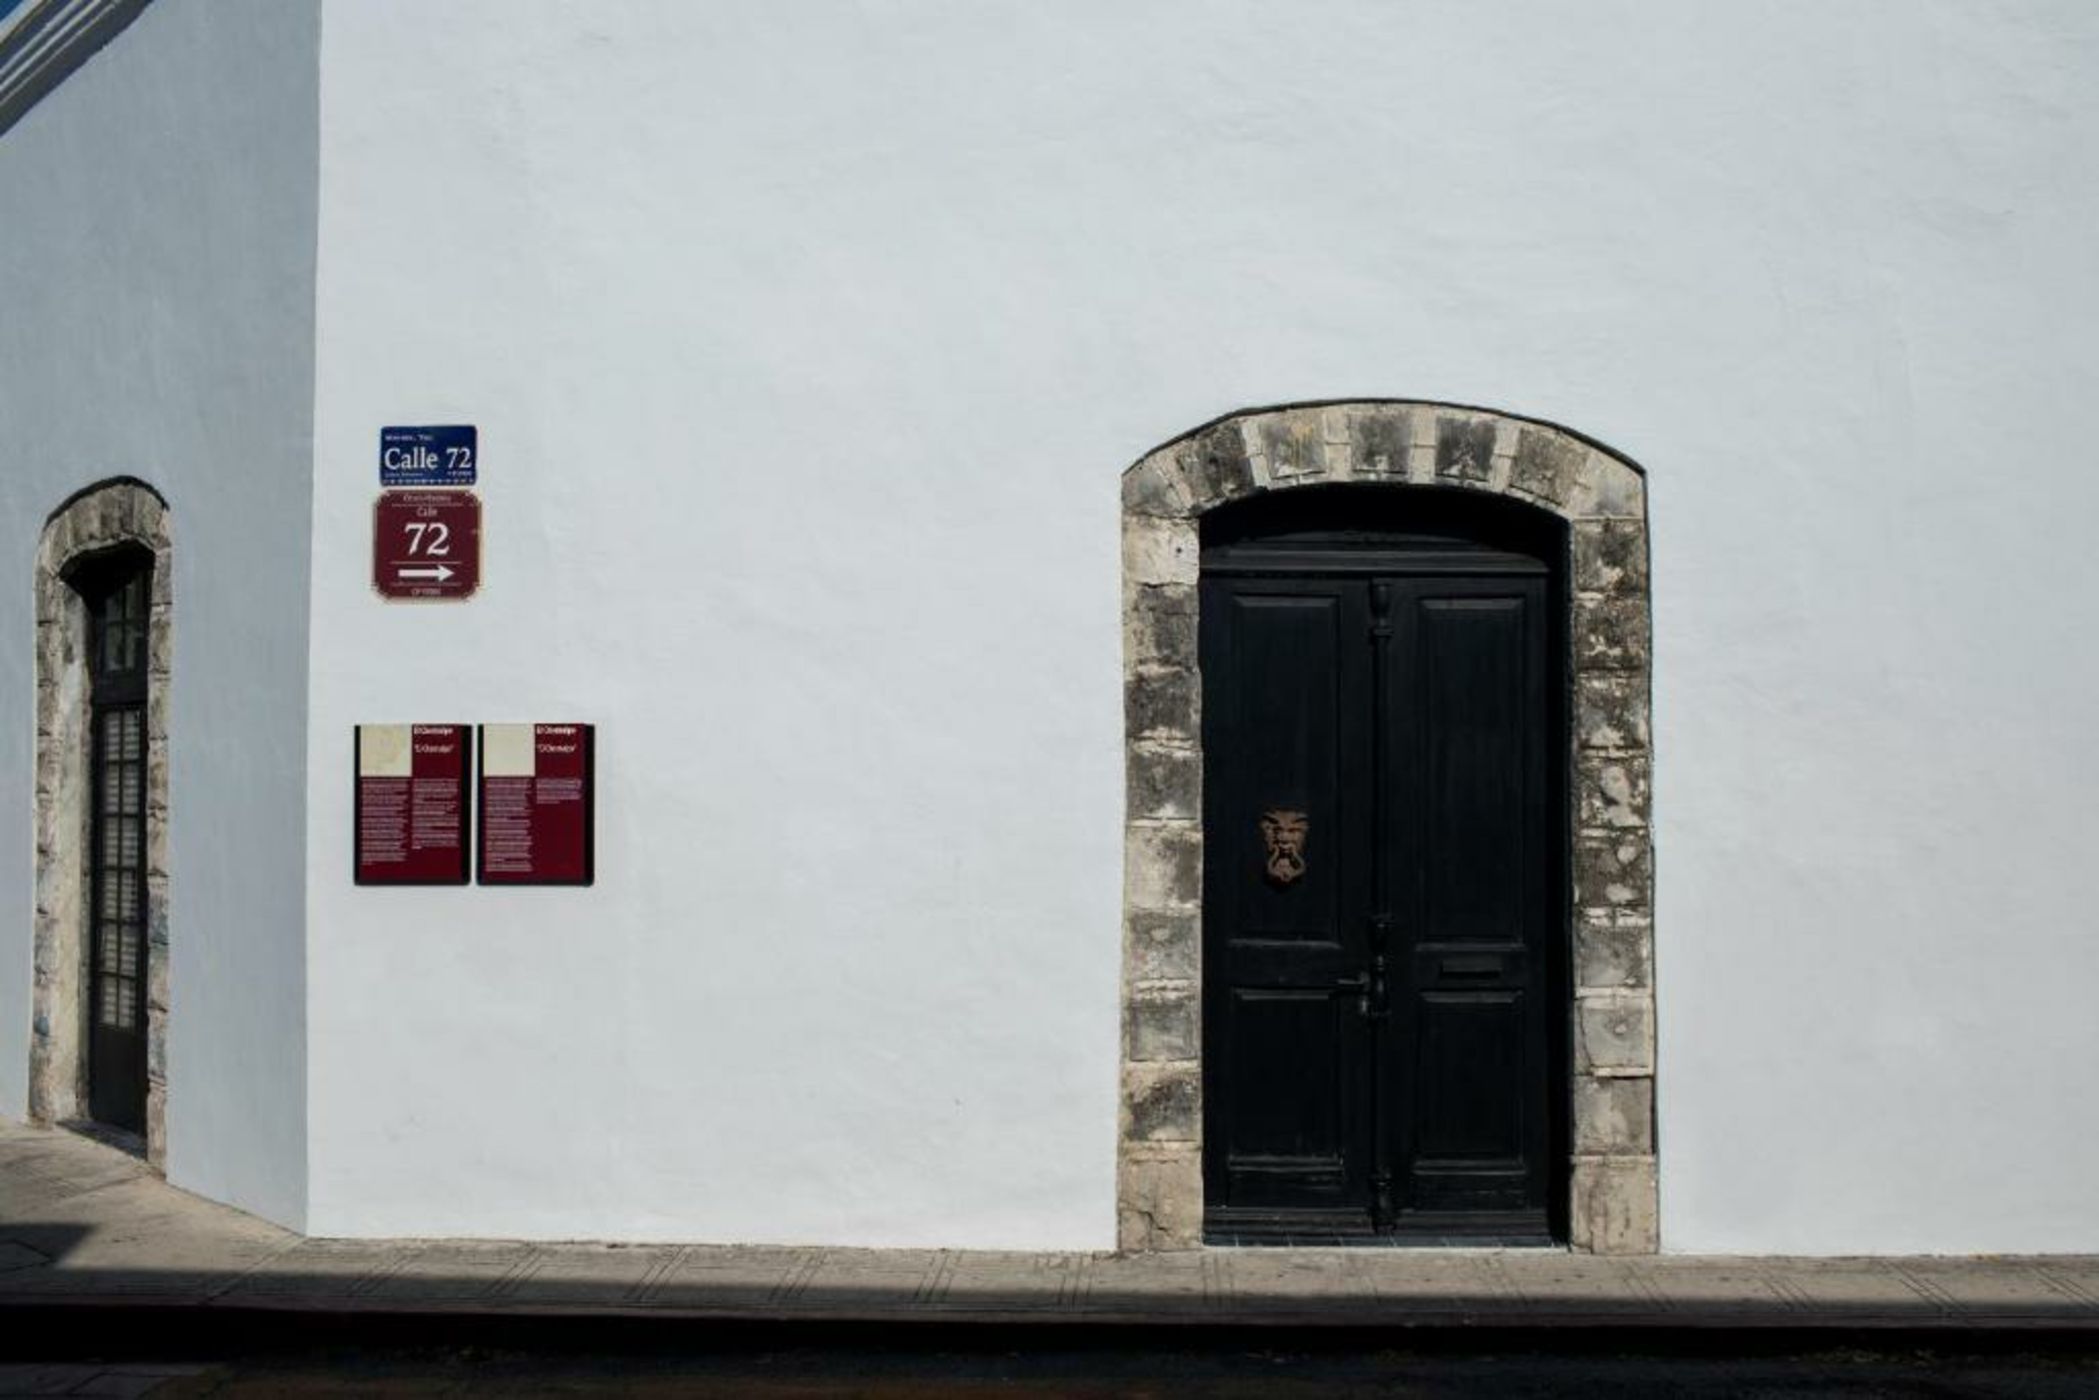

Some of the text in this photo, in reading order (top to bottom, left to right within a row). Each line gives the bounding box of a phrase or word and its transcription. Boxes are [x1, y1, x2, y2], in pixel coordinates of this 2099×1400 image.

[384, 446, 472, 470] Calle 72
[404, 522, 450, 556] 72
